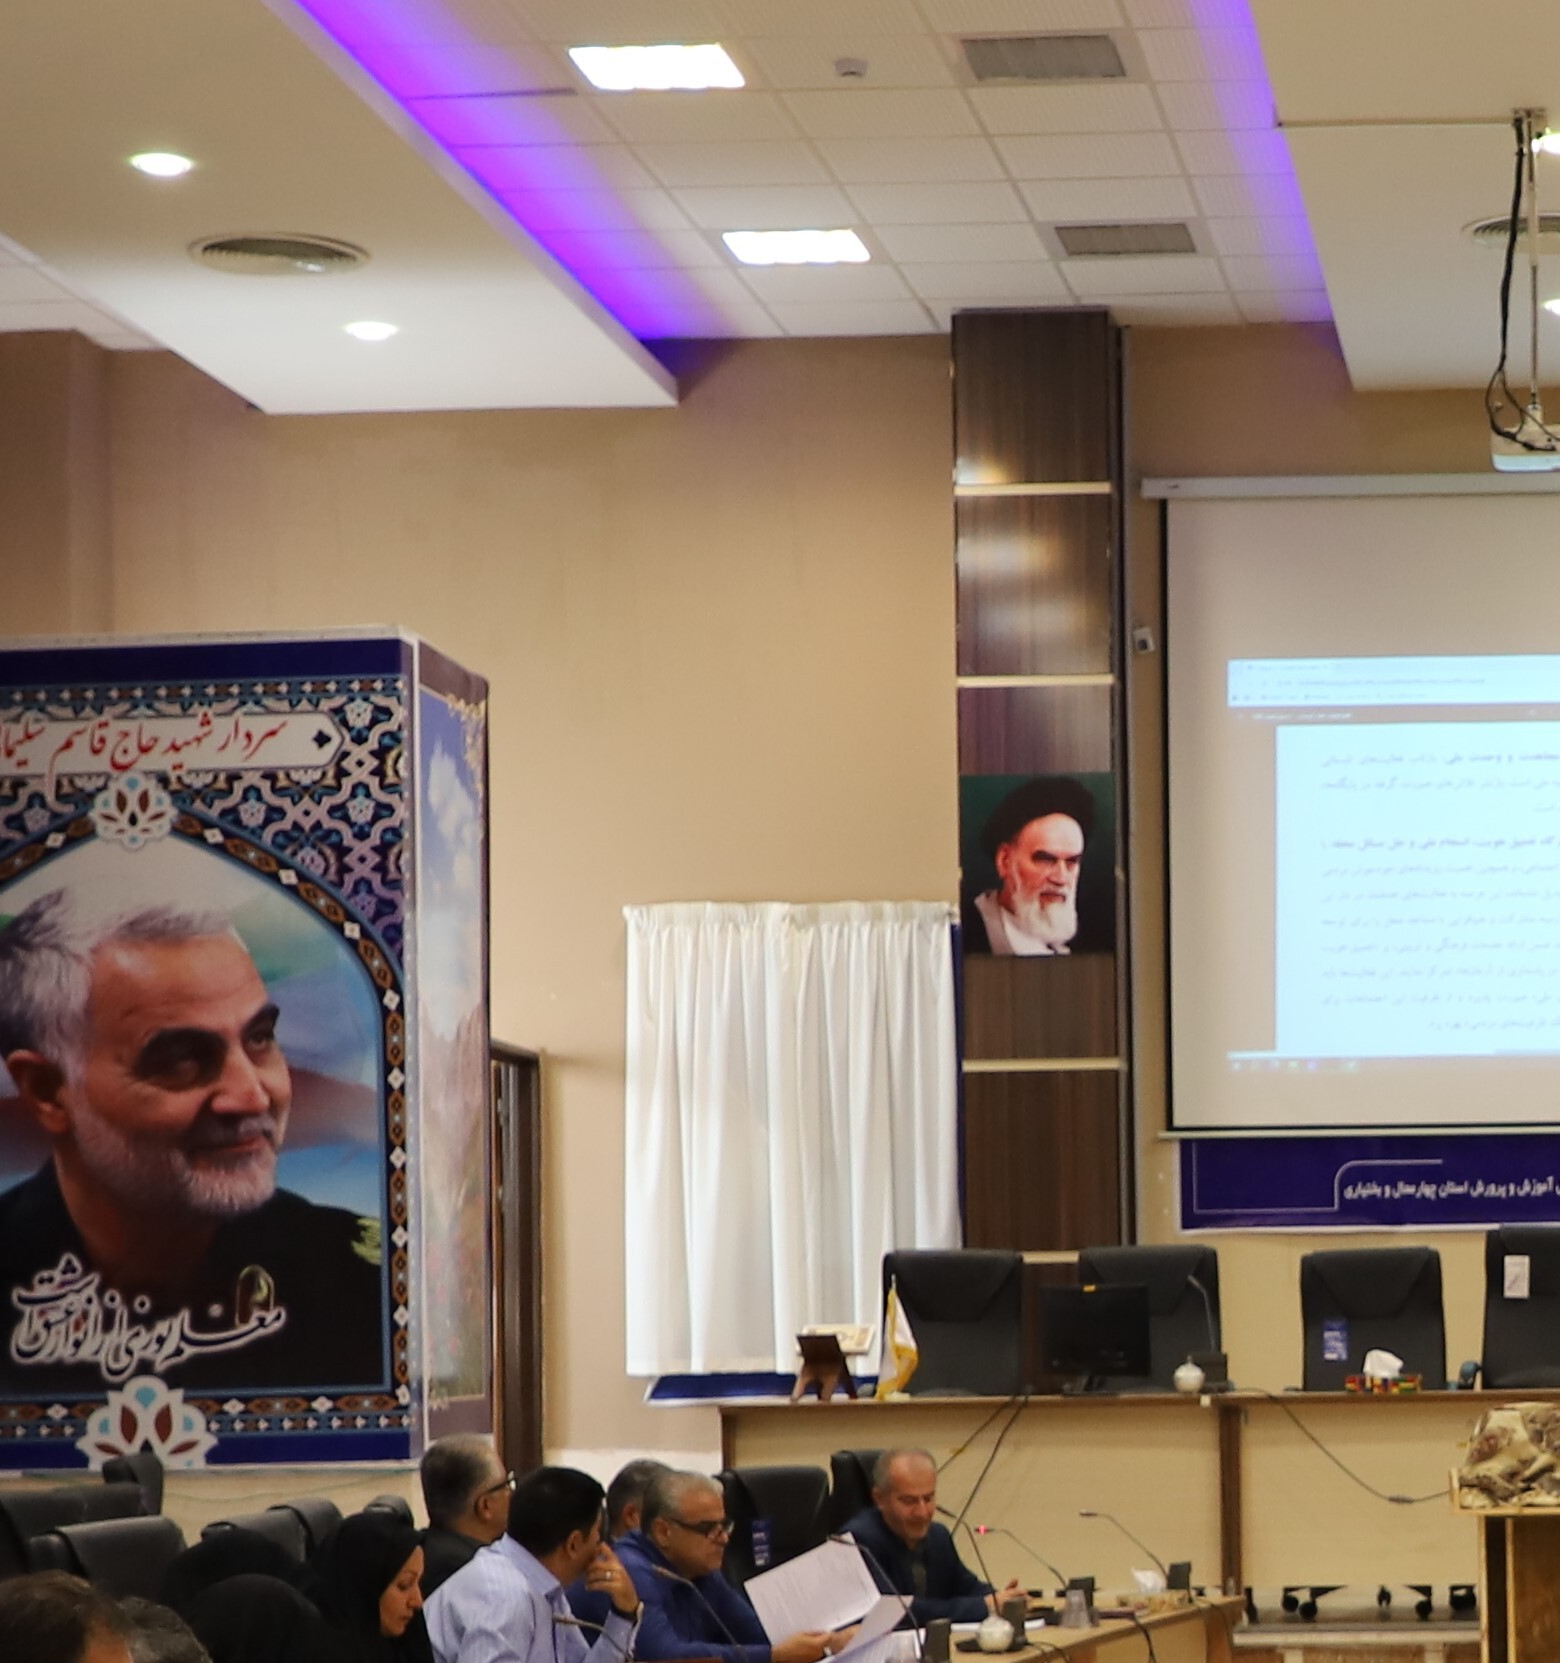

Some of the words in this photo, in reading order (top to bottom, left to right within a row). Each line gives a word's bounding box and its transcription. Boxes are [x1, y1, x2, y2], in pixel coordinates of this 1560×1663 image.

[47, 719, 111, 775] قاسم
[109, 721, 160, 772] حاج
[162, 710, 214, 772] شهید
[217, 717, 288, 762] سردار
[1343, 1180, 1383, 1200] بختیاری
[1384, 1183, 1391, 1199] و
[1438, 1179, 1469, 1199] استان
[1470, 1178, 1508, 1199] پرورش
[1507, 1181, 1515, 1198] و
[1516, 1175, 1554, 1198] آموزش
